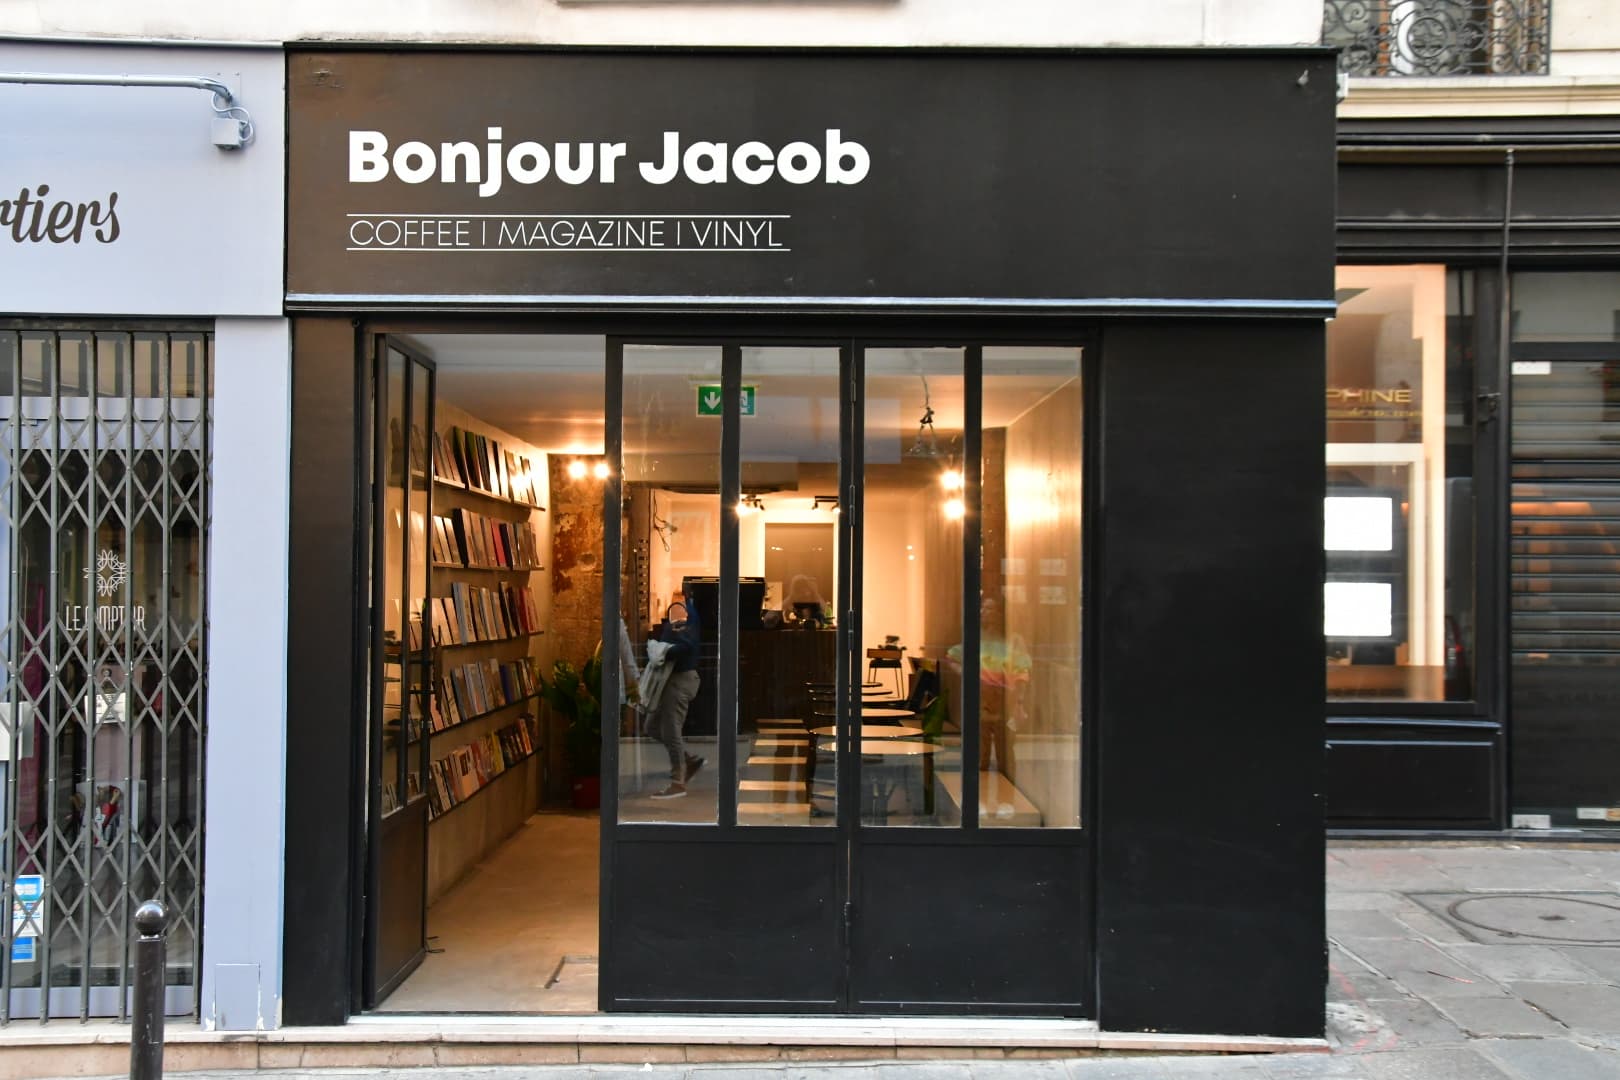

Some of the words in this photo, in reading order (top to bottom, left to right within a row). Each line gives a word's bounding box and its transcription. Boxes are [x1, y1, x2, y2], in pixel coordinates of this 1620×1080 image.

[348, 127, 627, 198] Bonjour
[638, 128, 871, 185] Jacob
[349, 219, 471, 247] COFFEE
[498, 220, 665, 247] MAGAZINE
[690, 221, 783, 247] VINYL
[65, 605, 81, 631] LE
